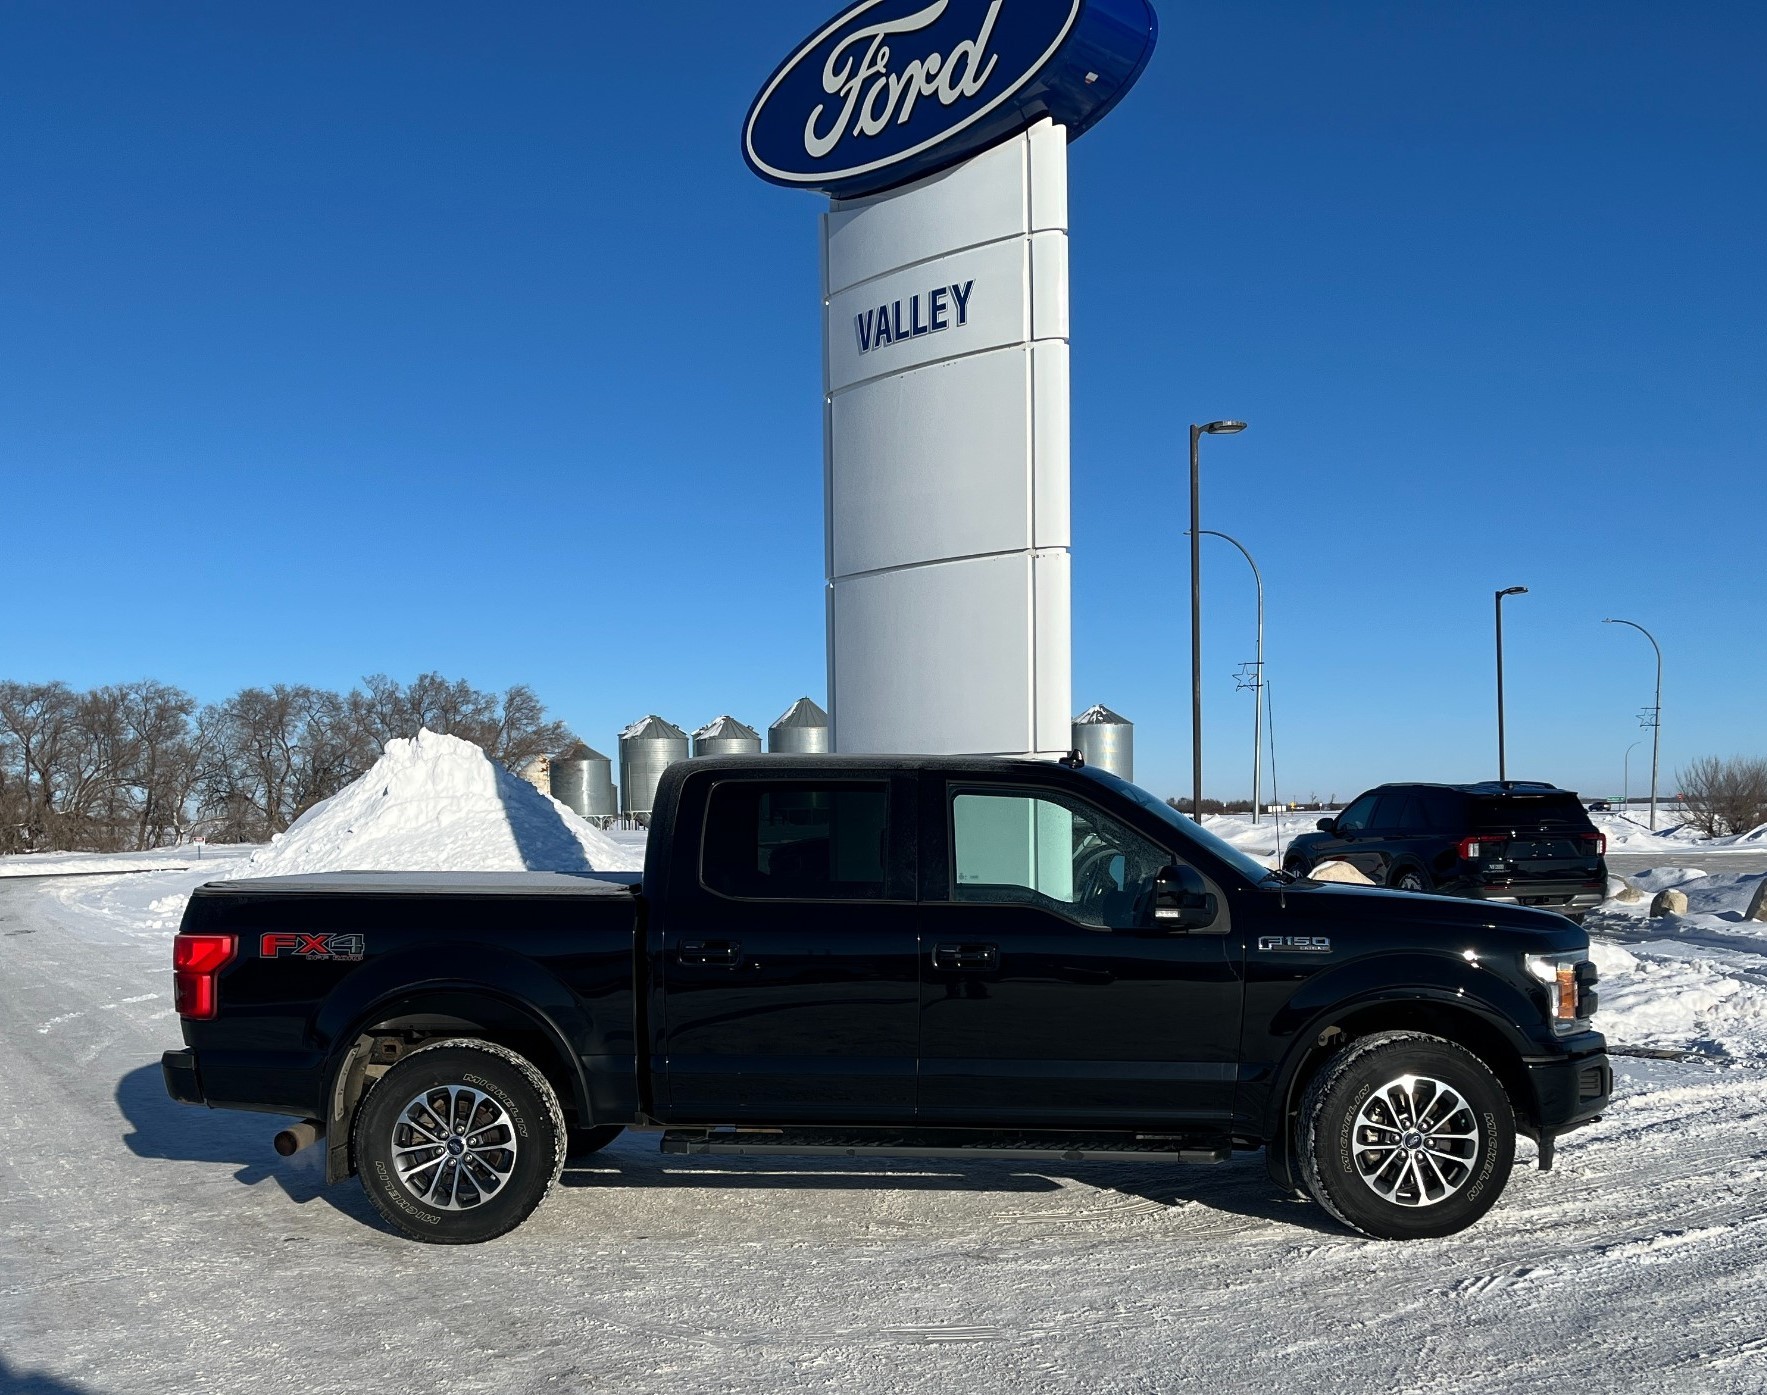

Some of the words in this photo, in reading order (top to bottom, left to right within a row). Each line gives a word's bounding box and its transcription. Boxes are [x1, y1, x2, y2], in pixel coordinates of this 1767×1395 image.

[804, 0, 1000, 158] Ford
[854, 278, 976, 356] VALLEY
[260, 932, 365, 958] FX4
[463, 1073, 528, 1138] MICHELIN
[1340, 1084, 1370, 1173] MICHELIN
[375, 1161, 441, 1225] MICHELIN
[1467, 1112, 1497, 1202] MICHELIN
